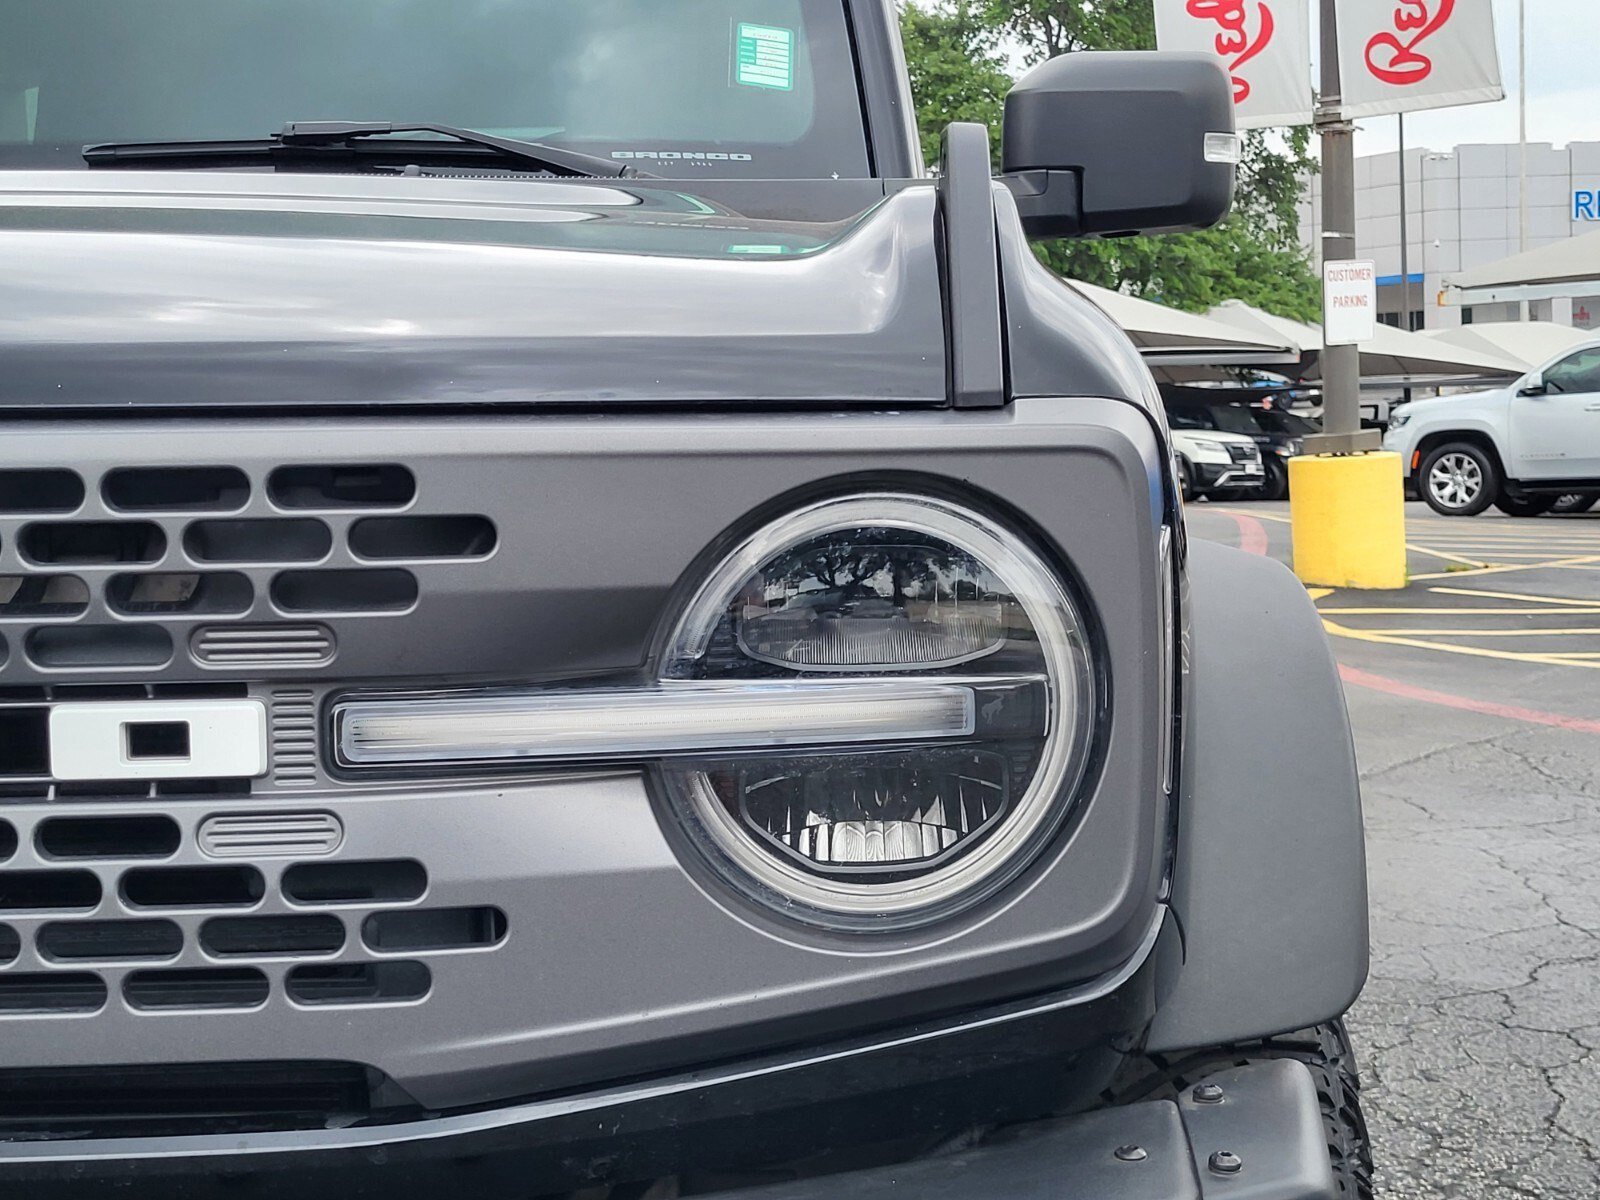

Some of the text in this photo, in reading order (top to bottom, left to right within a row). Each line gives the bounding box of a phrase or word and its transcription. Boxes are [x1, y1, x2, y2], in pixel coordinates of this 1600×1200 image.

[1364, 0, 1455, 85] Re
[611, 151, 752, 160] BRONCO
[1575, 191, 1600, 218] R
[1328, 268, 1371, 281] CUSTOMER
[1333, 295, 1368, 307] PARKING
